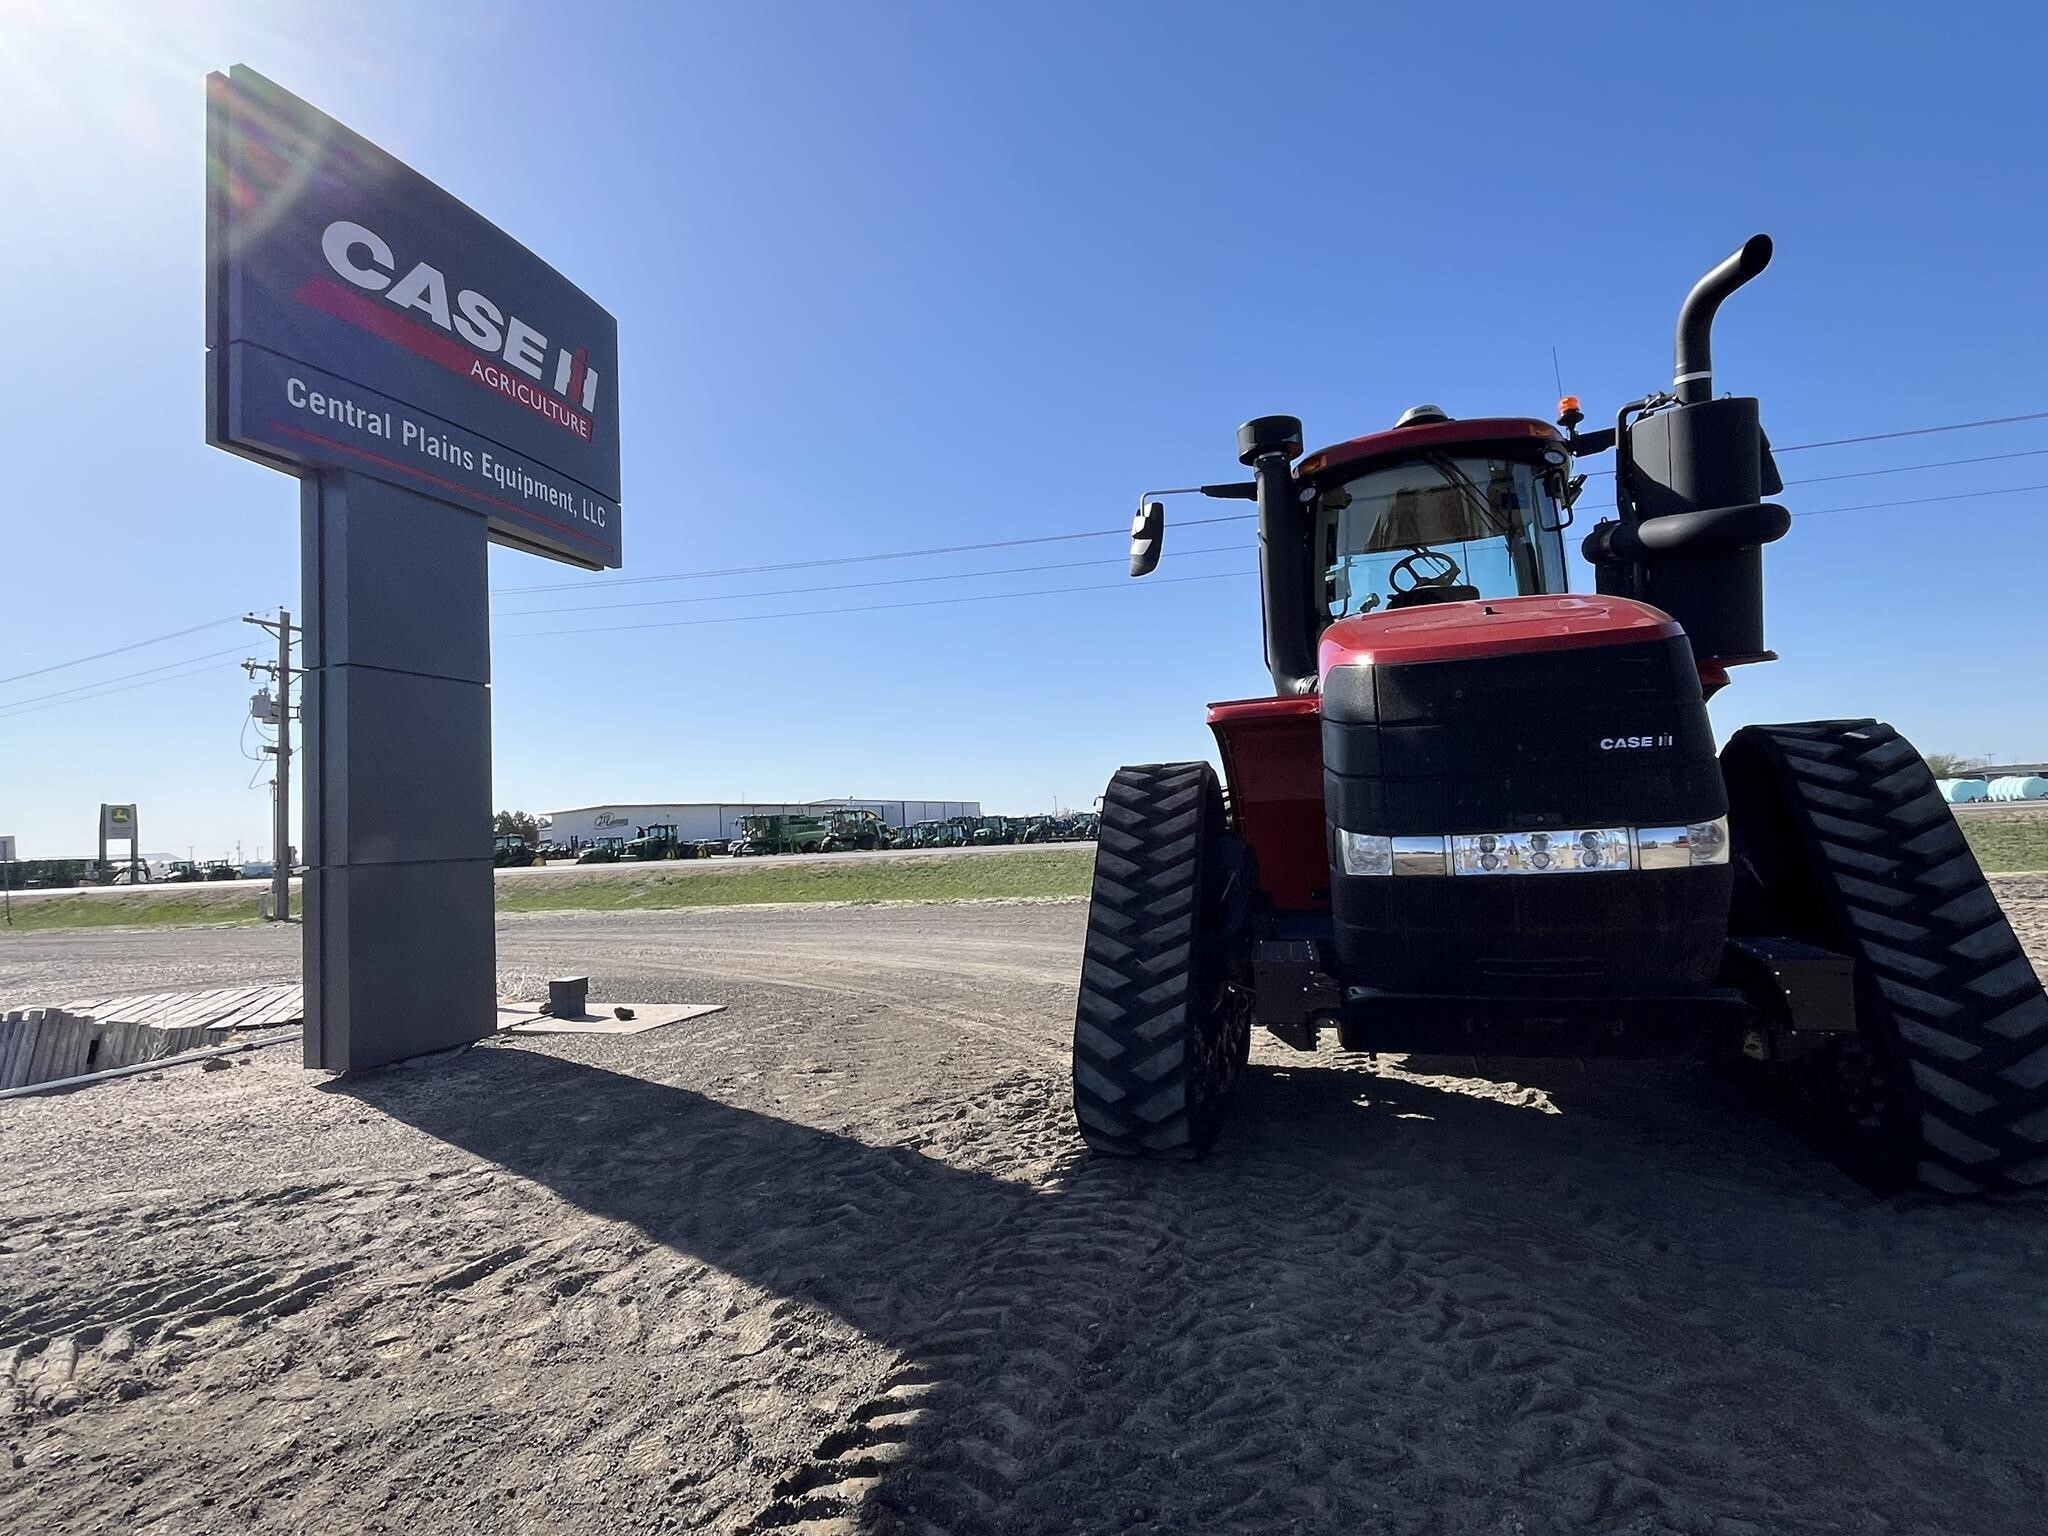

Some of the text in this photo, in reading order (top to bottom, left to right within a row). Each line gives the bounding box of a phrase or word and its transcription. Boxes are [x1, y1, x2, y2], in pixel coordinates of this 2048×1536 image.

[321, 220, 548, 380] CASE
[286, 376, 607, 528] Central Plains Equipment, LLC
[470, 359, 589, 438] AGRICULTURE
[1600, 736, 1653, 750] CASE
